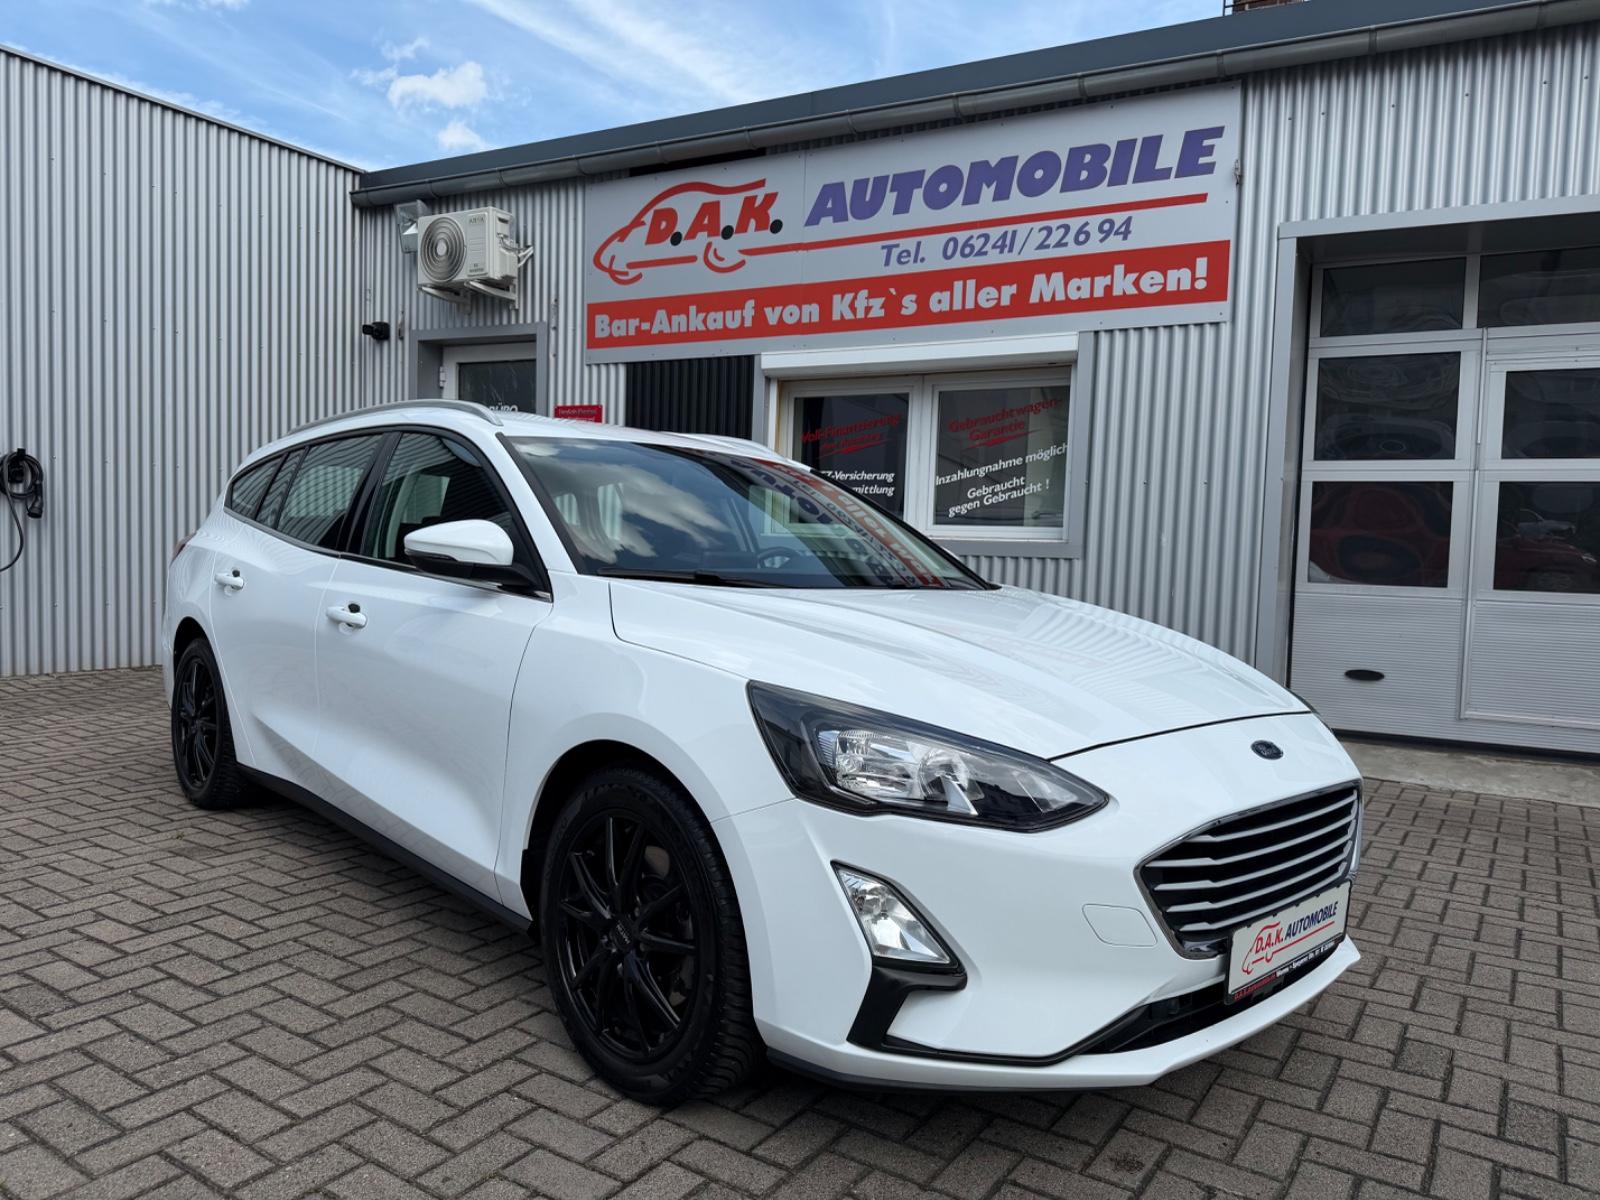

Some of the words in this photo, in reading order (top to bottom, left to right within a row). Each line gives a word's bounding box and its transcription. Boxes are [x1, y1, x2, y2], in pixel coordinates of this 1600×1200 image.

[645, 191, 783, 246] D.A.K.
[804, 126, 1224, 228] AUTOMOBILE
[881, 243, 926, 267] Tel.
[594, 299, 755, 339] Bar-Ankauf
[763, 302, 820, 326] von
[929, 280, 1017, 314] aller
[1029, 256, 1209, 304] Marken!
[968, 420, 1025, 441] Garantie
[935, 459, 1023, 485] Inzahlungnahme
[1025, 442, 1070, 463] möglich
[948, 499, 981, 518] gegen
[983, 482, 1043, 506] Gebraucht
[967, 475, 1025, 499] Gebraucht
[1255, 927, 1284, 955] D.A.K.
[1285, 900, 1339, 941] AUTOMOBILE
